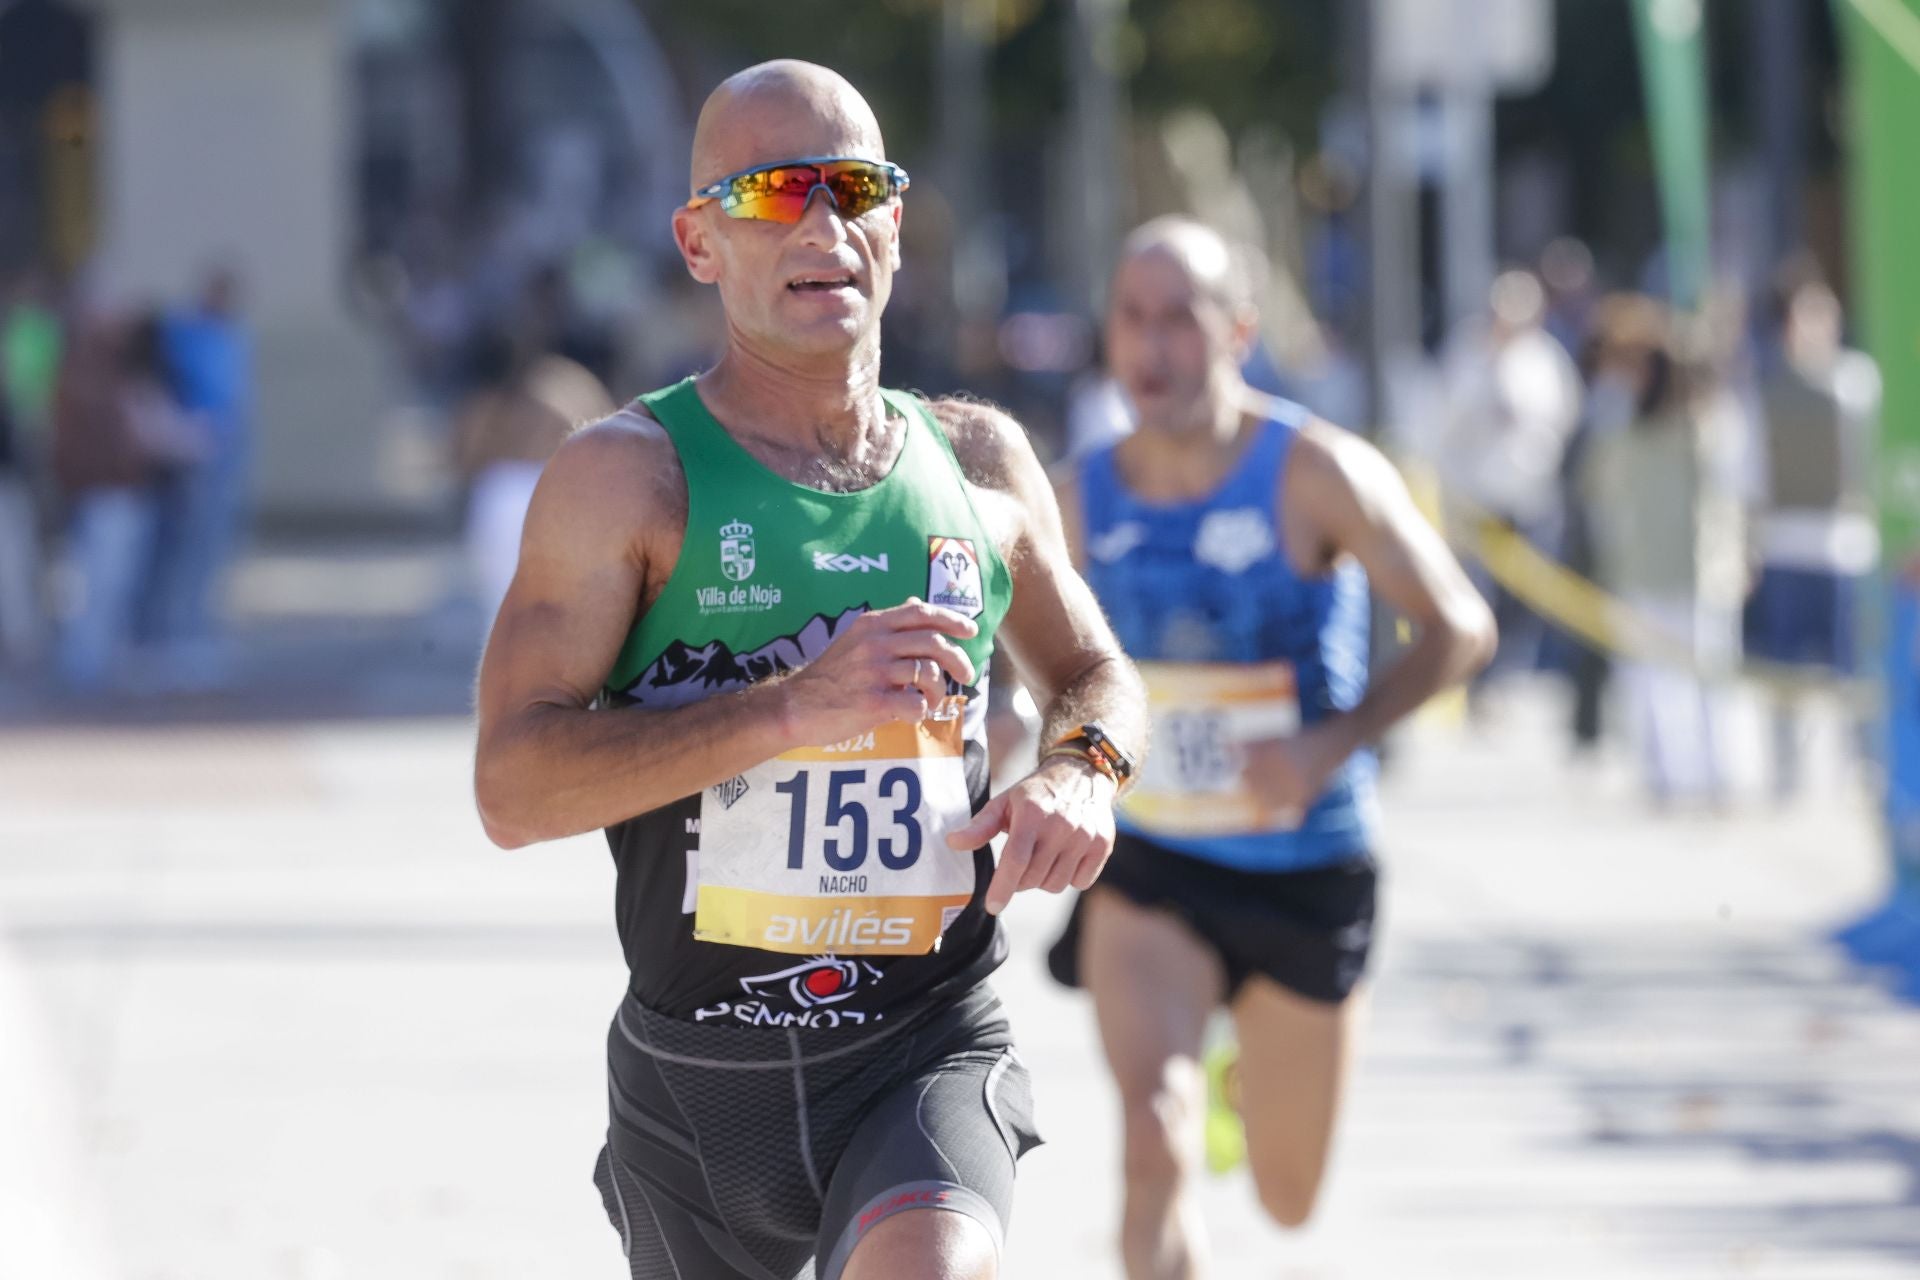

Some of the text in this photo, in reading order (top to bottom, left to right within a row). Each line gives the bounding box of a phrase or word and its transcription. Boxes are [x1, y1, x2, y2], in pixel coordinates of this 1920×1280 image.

[696, 583, 782, 610] Villa de Noja
[775, 766, 923, 872] 153
[819, 875, 868, 893] NACHO
[763, 909, 915, 946] avilés
